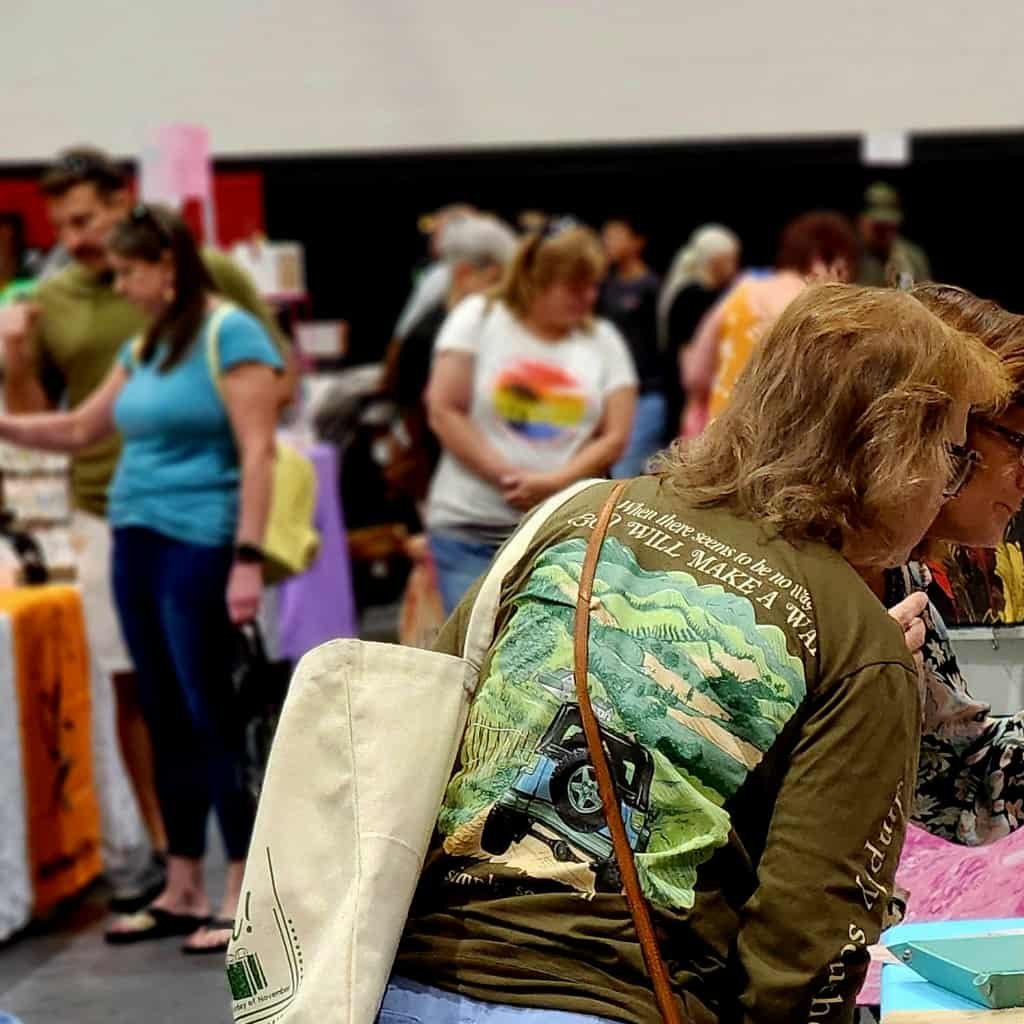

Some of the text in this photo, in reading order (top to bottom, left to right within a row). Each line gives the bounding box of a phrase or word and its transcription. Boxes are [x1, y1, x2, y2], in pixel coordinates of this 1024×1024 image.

[616, 500, 657, 520] When
[656, 514, 694, 538] there
[692, 531, 736, 557] seems
[734, 552, 752, 568] to
[751, 559, 772, 576] be
[769, 573, 791, 589] no
[627, 521, 684, 558] WILL
[688, 549, 762, 595] MAKE
[758, 591, 779, 610] A
[786, 603, 818, 657] WA
